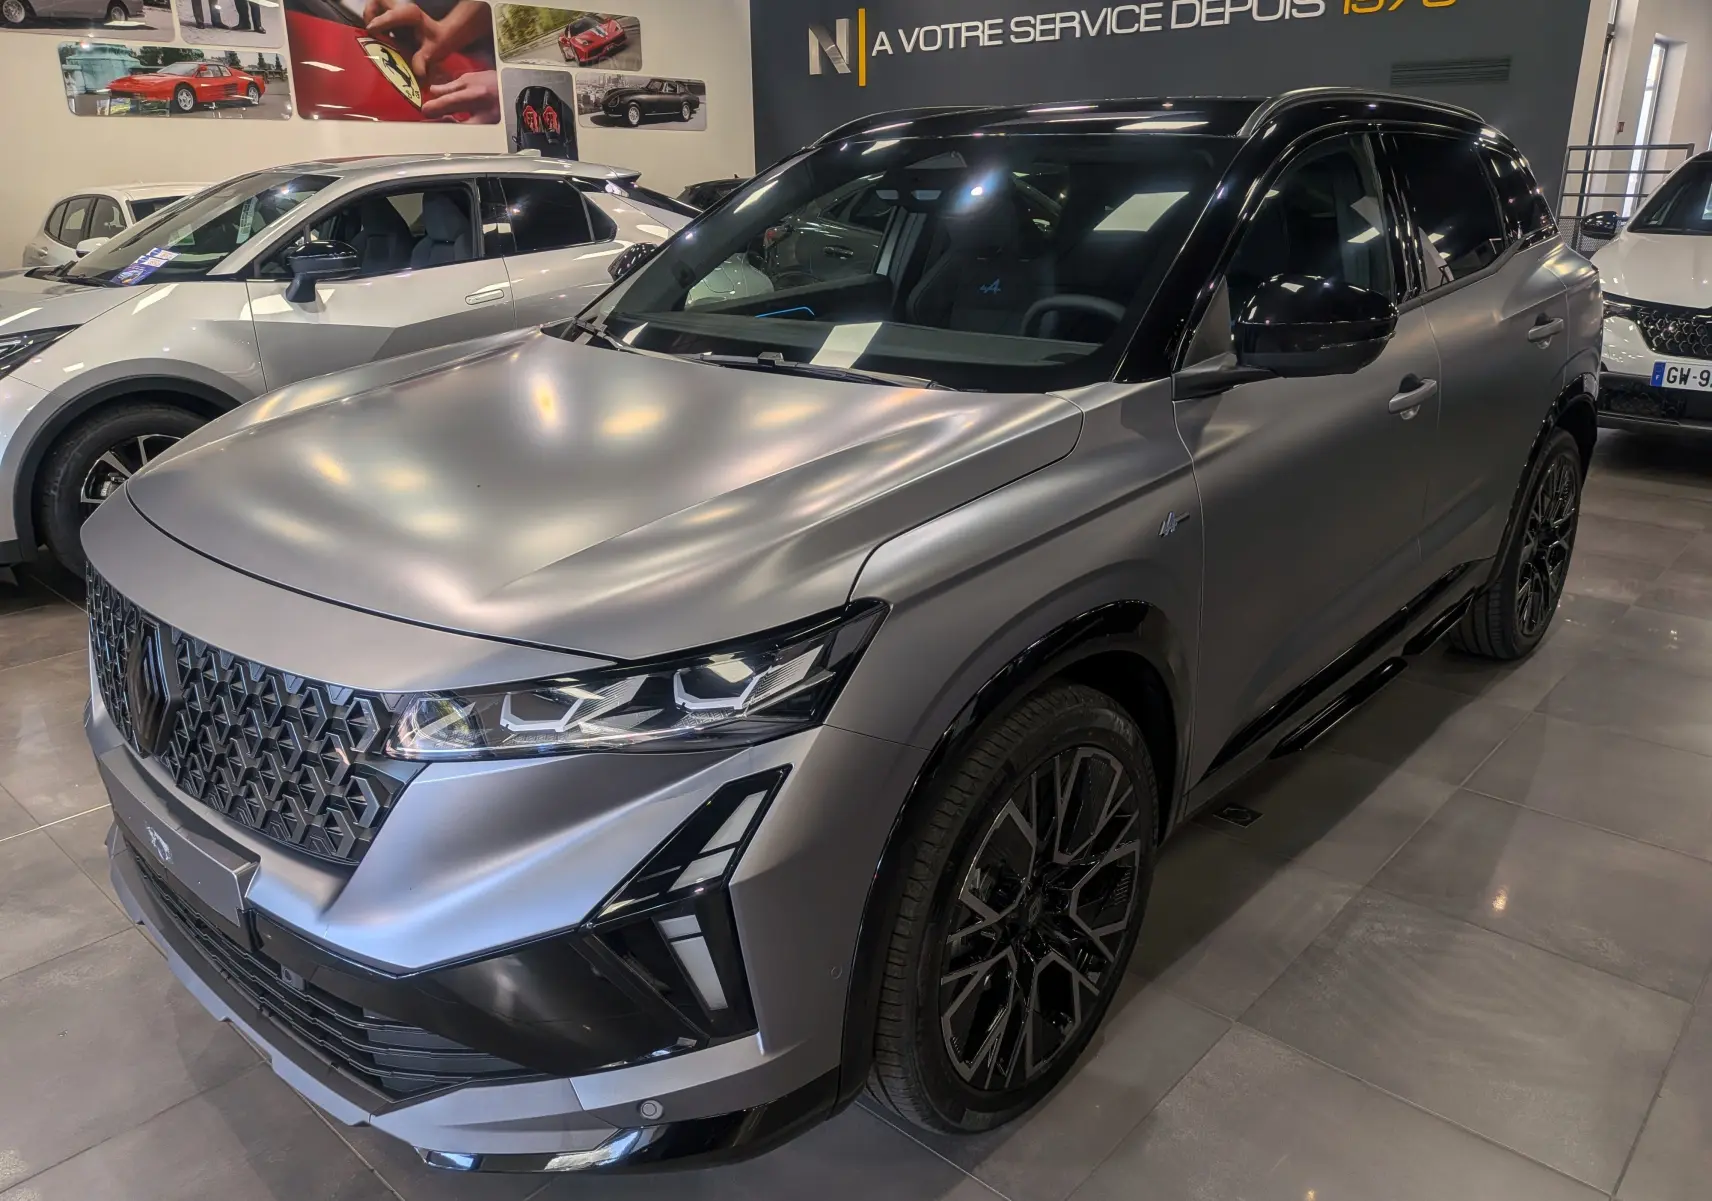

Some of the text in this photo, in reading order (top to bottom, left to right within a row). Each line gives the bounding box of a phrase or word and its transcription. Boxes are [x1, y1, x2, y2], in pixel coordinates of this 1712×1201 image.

[871, 31, 894, 57] A
[898, 18, 1004, 53] VOTRE
[1009, 2, 1164, 44] SERVICE
[1170, 0, 1326, 29] DEPUIS
[1666, 366, 1712, 388] GW-9
